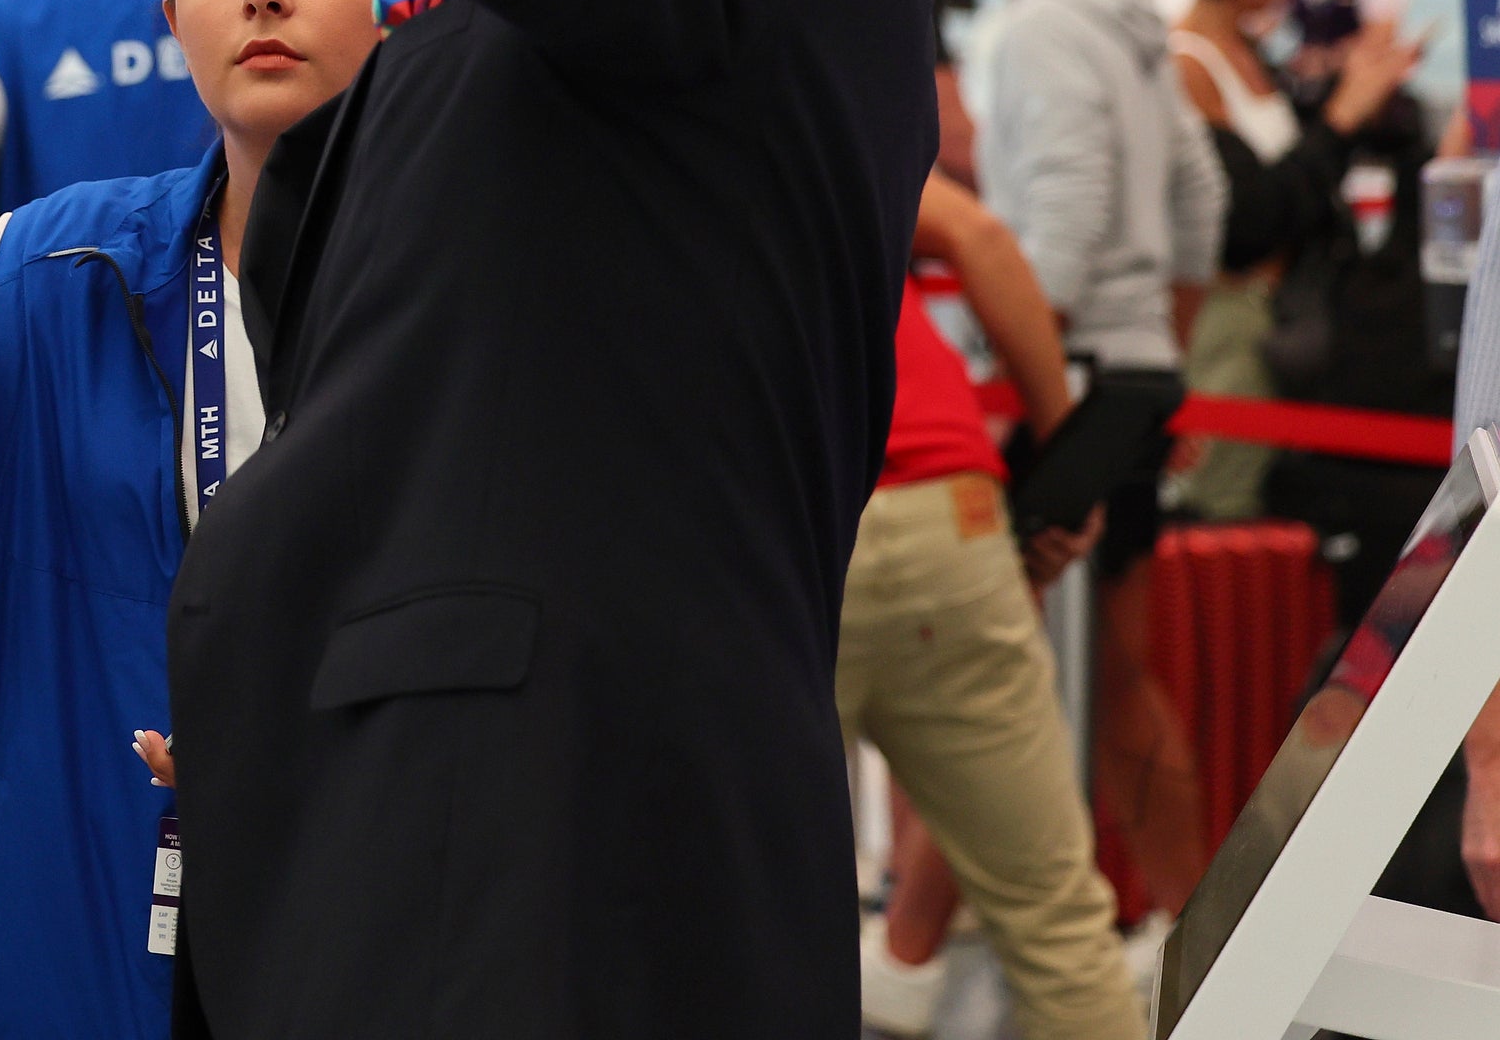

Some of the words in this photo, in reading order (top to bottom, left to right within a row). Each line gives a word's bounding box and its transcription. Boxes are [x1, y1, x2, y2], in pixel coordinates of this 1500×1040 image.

[111, 35, 192, 87] DE
[197, 236, 217, 328] DELTA
[200, 406, 219, 460] MTH
